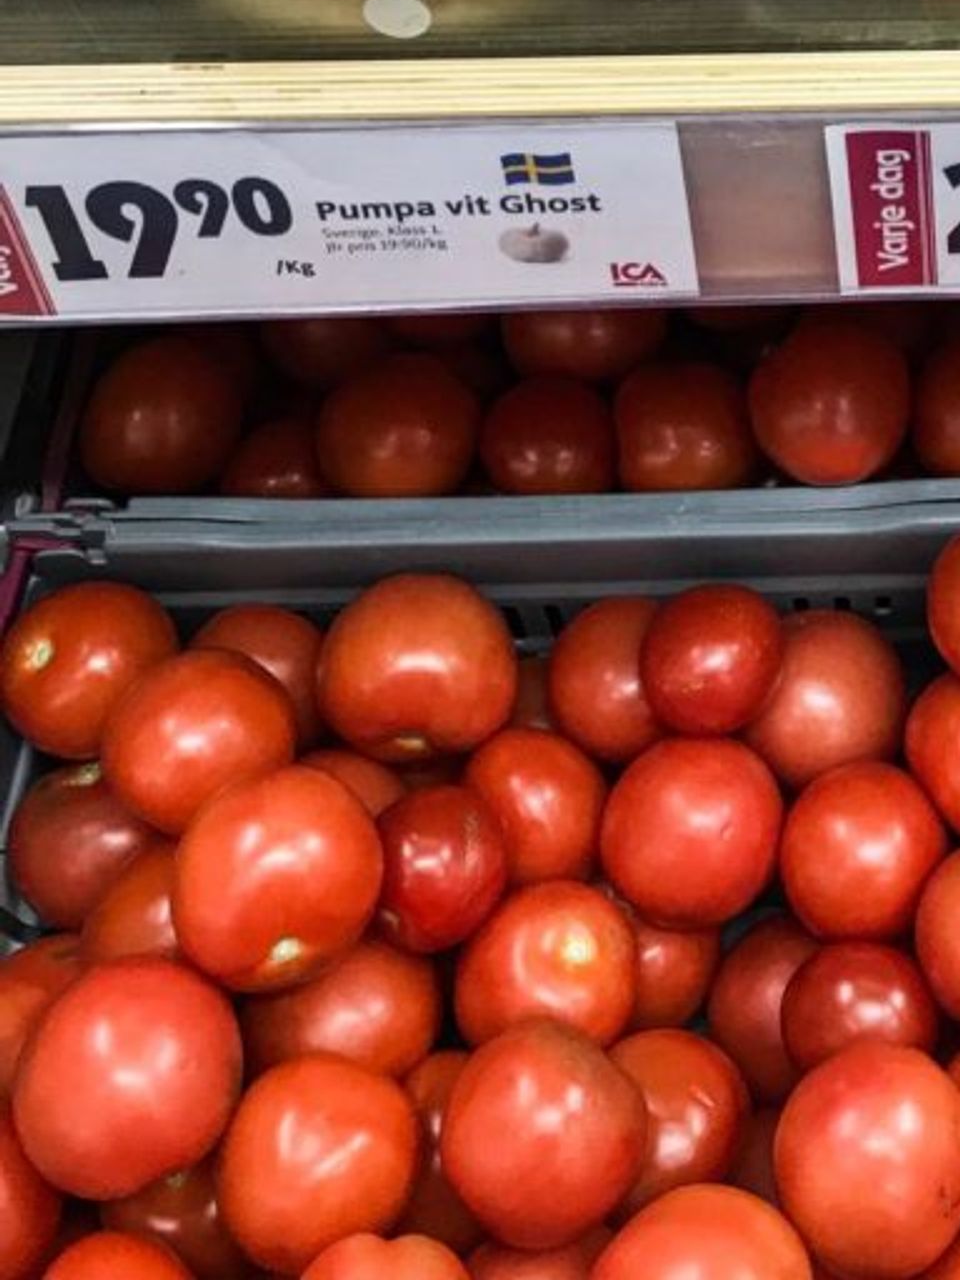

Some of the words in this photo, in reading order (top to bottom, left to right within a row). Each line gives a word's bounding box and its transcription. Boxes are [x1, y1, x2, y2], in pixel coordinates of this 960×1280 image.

[869, 149, 912, 200] dag
[316, 201, 436, 223] Pumpa
[445, 195, 491, 216] vit
[500, 193, 602, 214] Ghost
[872, 205, 916, 271] Varje
[610, 262, 667, 281] ICA
